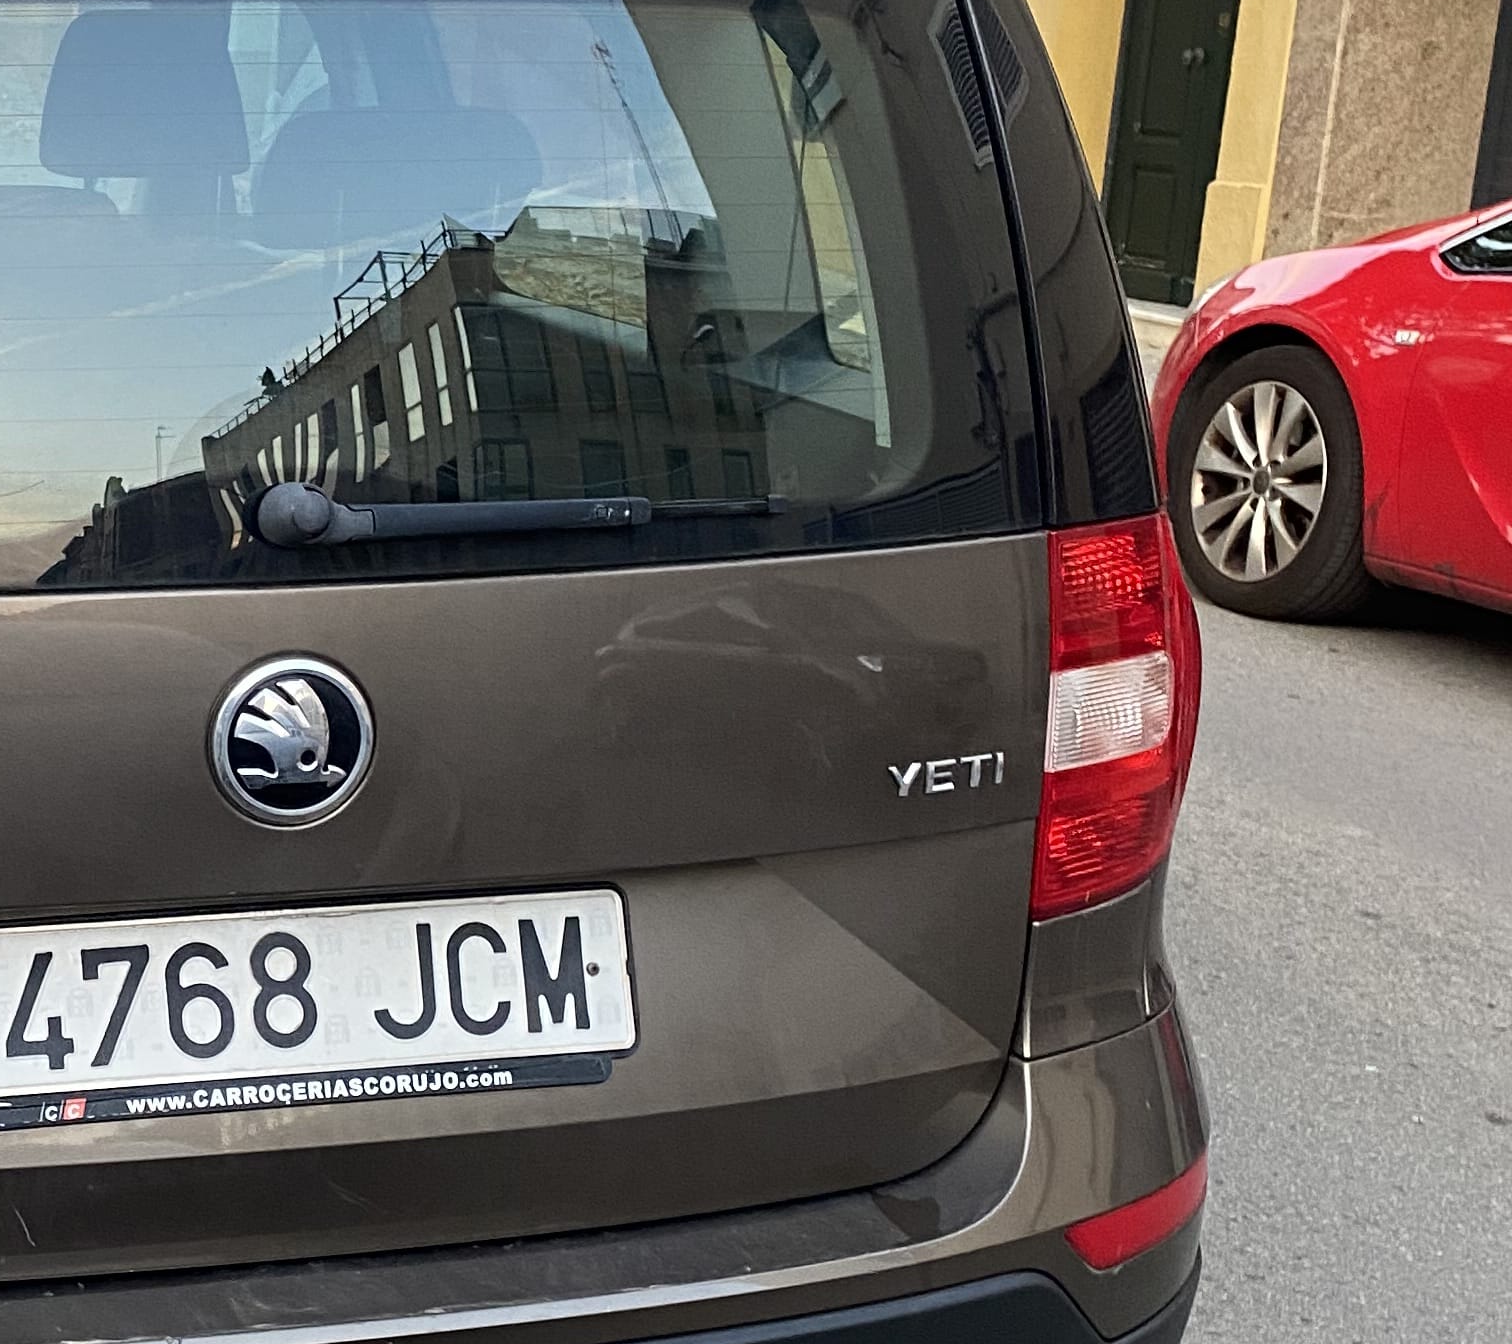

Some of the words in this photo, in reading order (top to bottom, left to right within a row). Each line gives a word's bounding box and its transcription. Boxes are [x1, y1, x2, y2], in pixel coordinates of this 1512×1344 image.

[888, 751, 1005, 797] YETI
[6, 932, 318, 1070] 4768
[374, 916, 590, 1040] JCM
